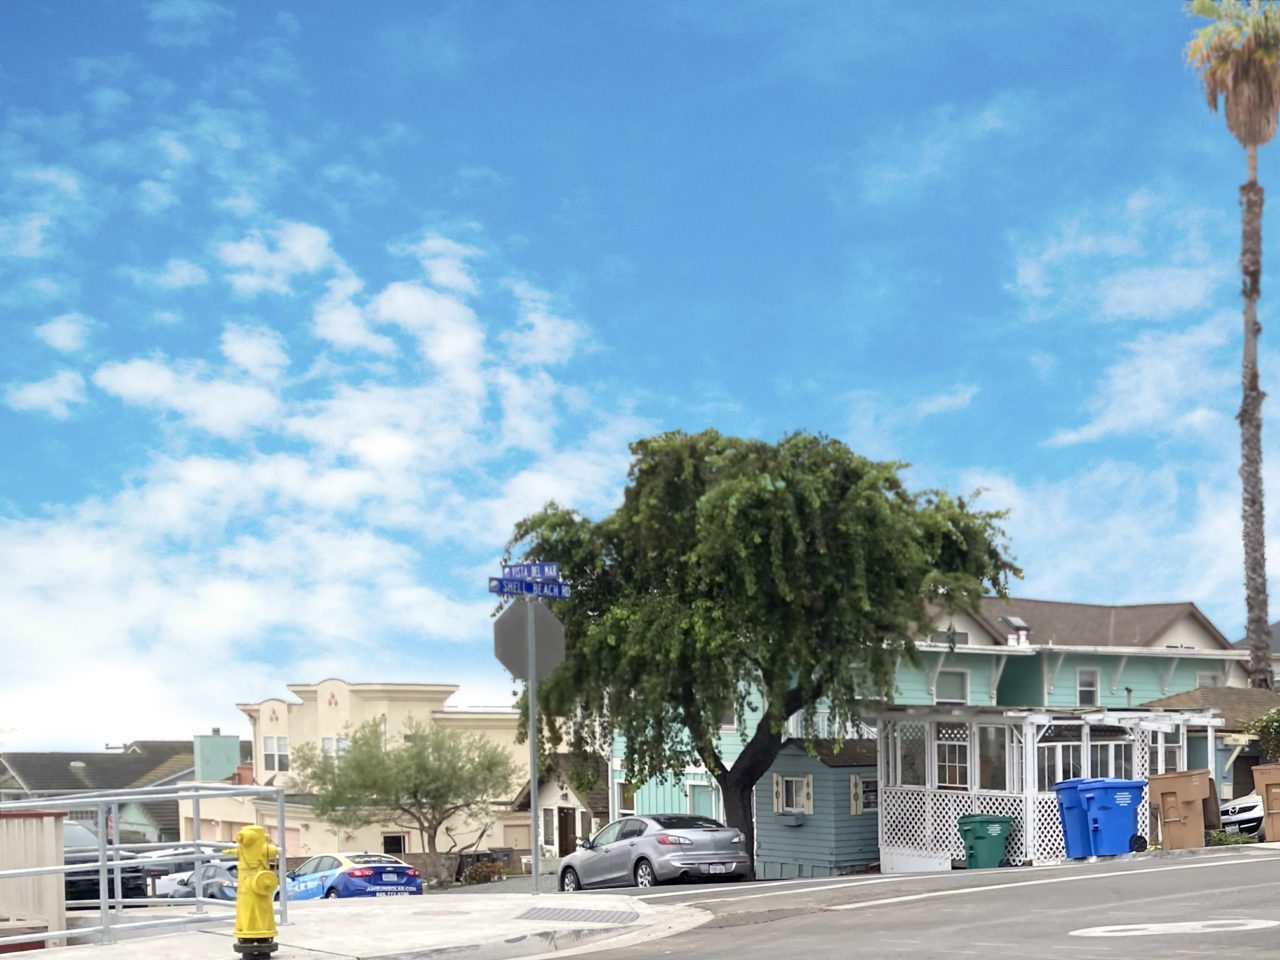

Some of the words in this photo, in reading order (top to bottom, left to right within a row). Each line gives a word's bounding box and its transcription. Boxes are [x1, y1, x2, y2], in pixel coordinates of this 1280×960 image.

[511, 566, 528, 577] VISTA
[531, 565, 541, 577] DEL
[544, 564, 557, 577] MAR
[502, 580, 526, 594] SHELL
[532, 583, 559, 596] BEACH
[561, 584, 571, 597] RD
